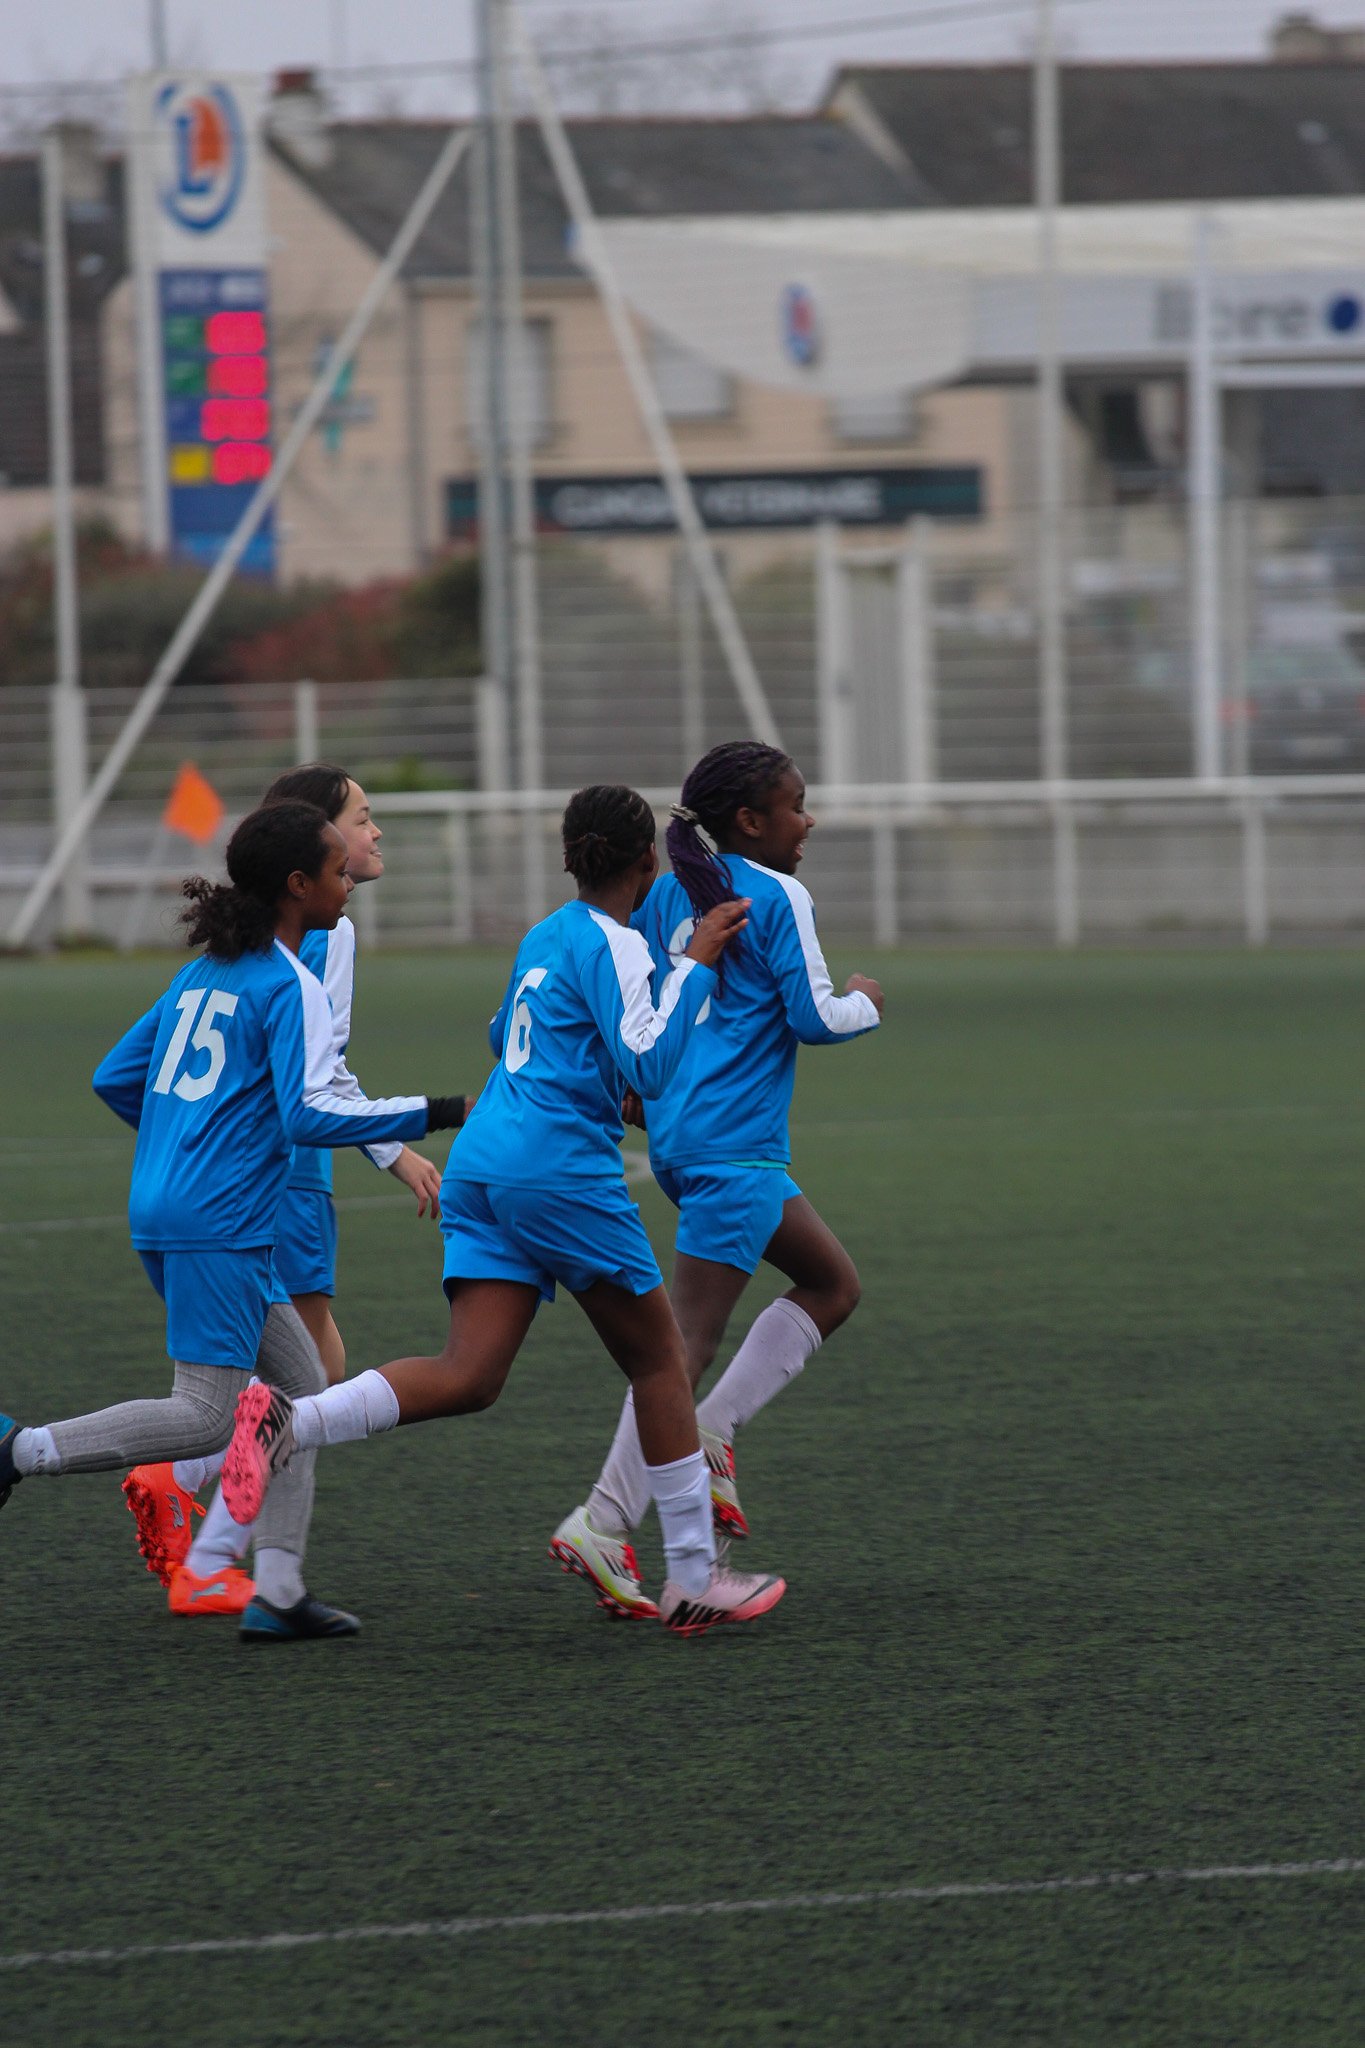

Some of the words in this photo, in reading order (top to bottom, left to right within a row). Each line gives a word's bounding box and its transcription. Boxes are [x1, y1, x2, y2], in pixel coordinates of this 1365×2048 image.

[152, 987, 239, 1102] 15
[505, 967, 548, 1074] 6
[255, 1390, 292, 1454] NIKE
